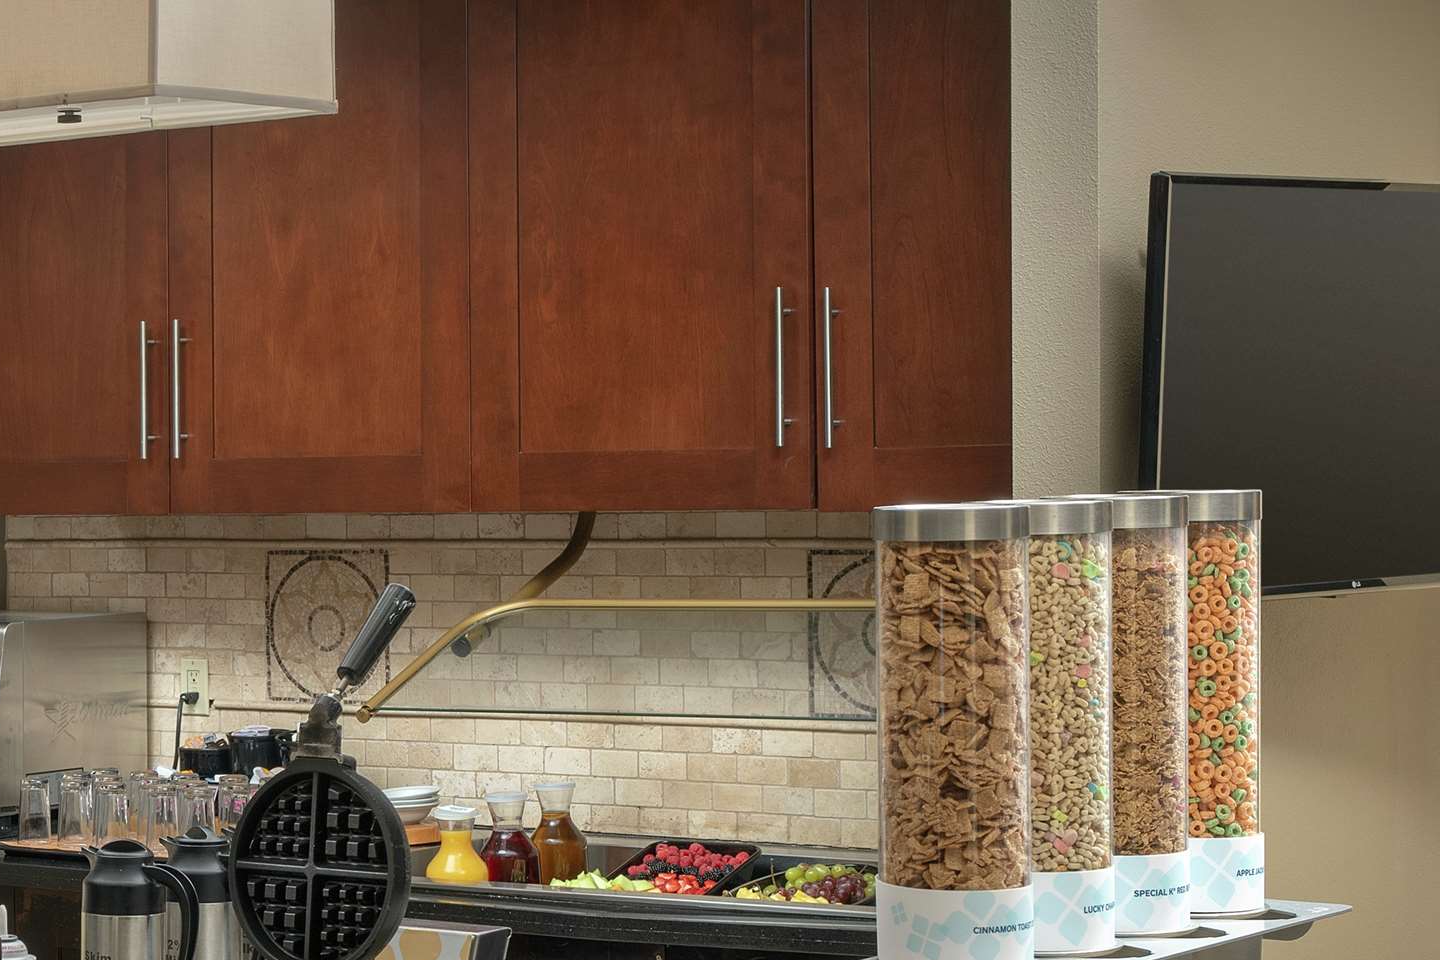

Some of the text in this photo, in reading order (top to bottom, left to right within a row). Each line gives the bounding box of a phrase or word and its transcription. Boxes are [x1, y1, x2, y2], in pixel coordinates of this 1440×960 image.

[1236, 868, 1255, 877] APPLE
[1133, 887, 1168, 897] SPECIAL
[1083, 903, 1105, 914] LUCKY
[973, 924, 1017, 935] CINNAMON
